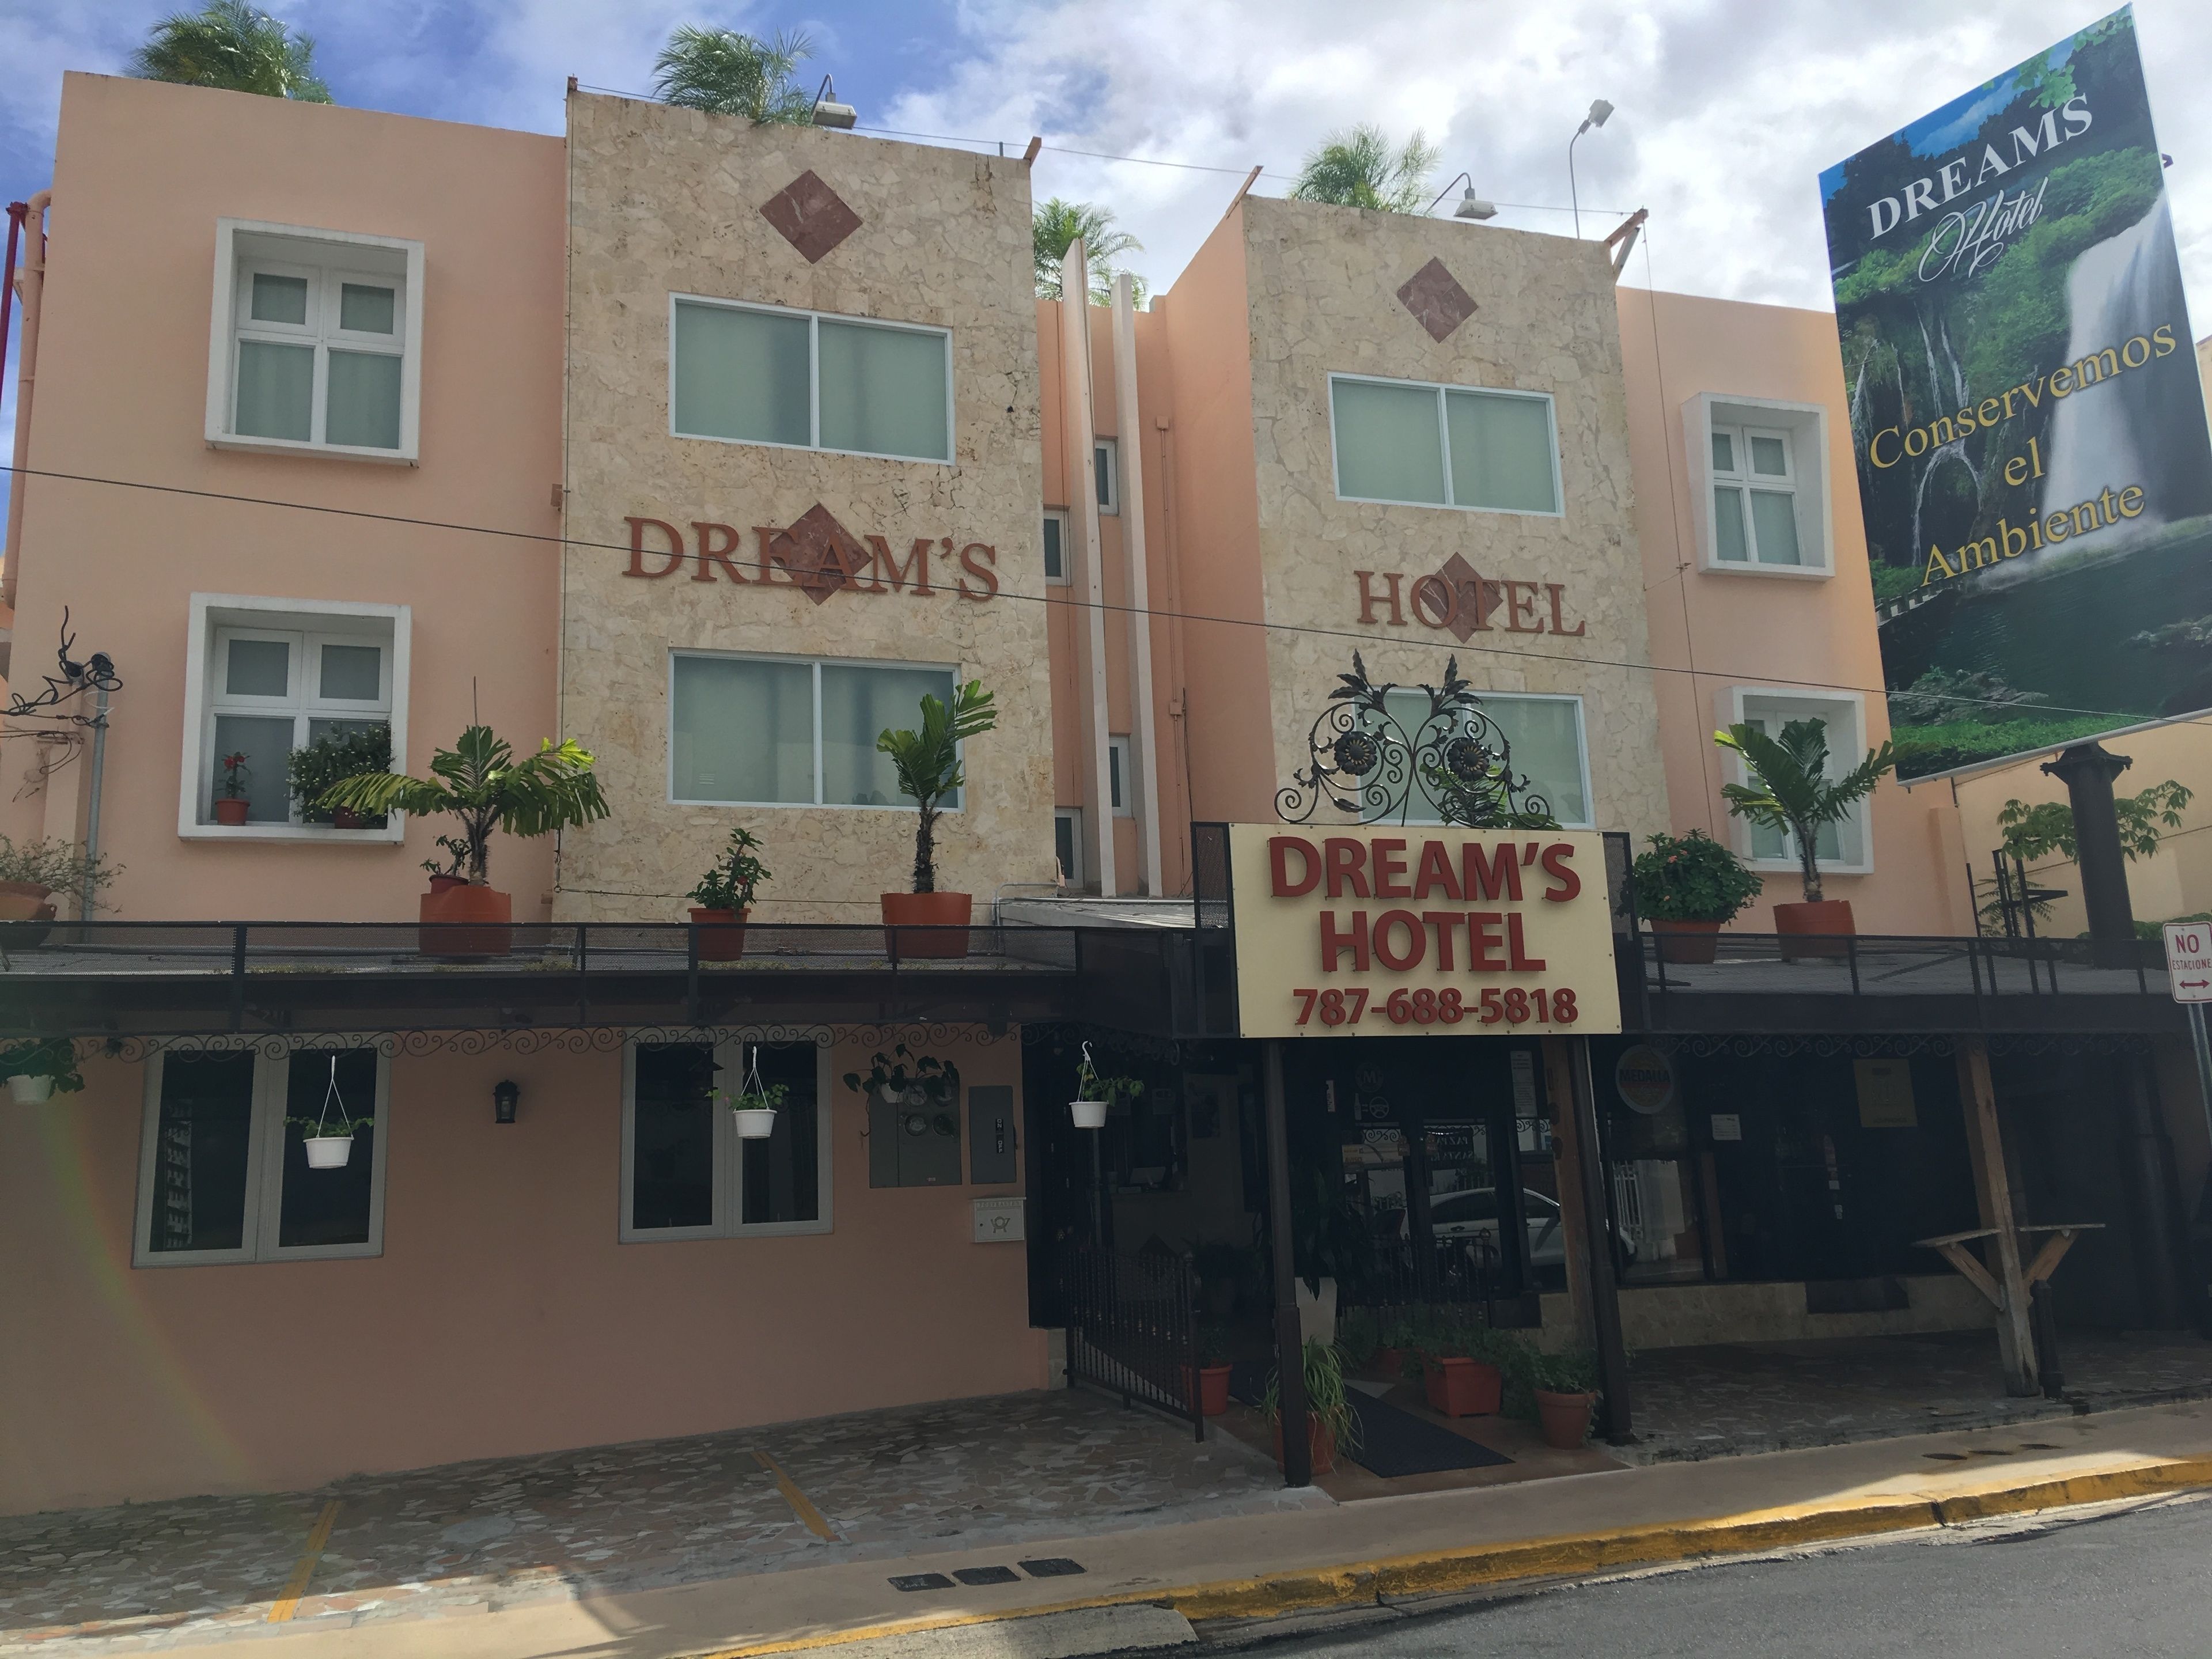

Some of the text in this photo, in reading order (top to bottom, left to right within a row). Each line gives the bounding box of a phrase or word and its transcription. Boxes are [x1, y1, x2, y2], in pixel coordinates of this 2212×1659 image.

[1866, 93, 2093, 240] DREAMS
[1918, 176, 2049, 282] Hotel
[1869, 323, 2176, 468] Conservemos
[2004, 437, 2046, 486] el
[622, 516, 999, 602] DREAM'S
[1920, 484, 2146, 586] Ambiente
[1354, 570, 1585, 637] HOTEL
[1268, 836, 1581, 903] DREAM'S
[1319, 909, 1546, 972] HOTEL
[2172, 958, 2212, 970] ESTACIONE
[2175, 934, 2199, 953] NO
[1293, 987, 1578, 1025] 787-688-5818
[1619, 1069, 1671, 1082] MEDALLA
[997, 1119, 1002, 1128] ON
